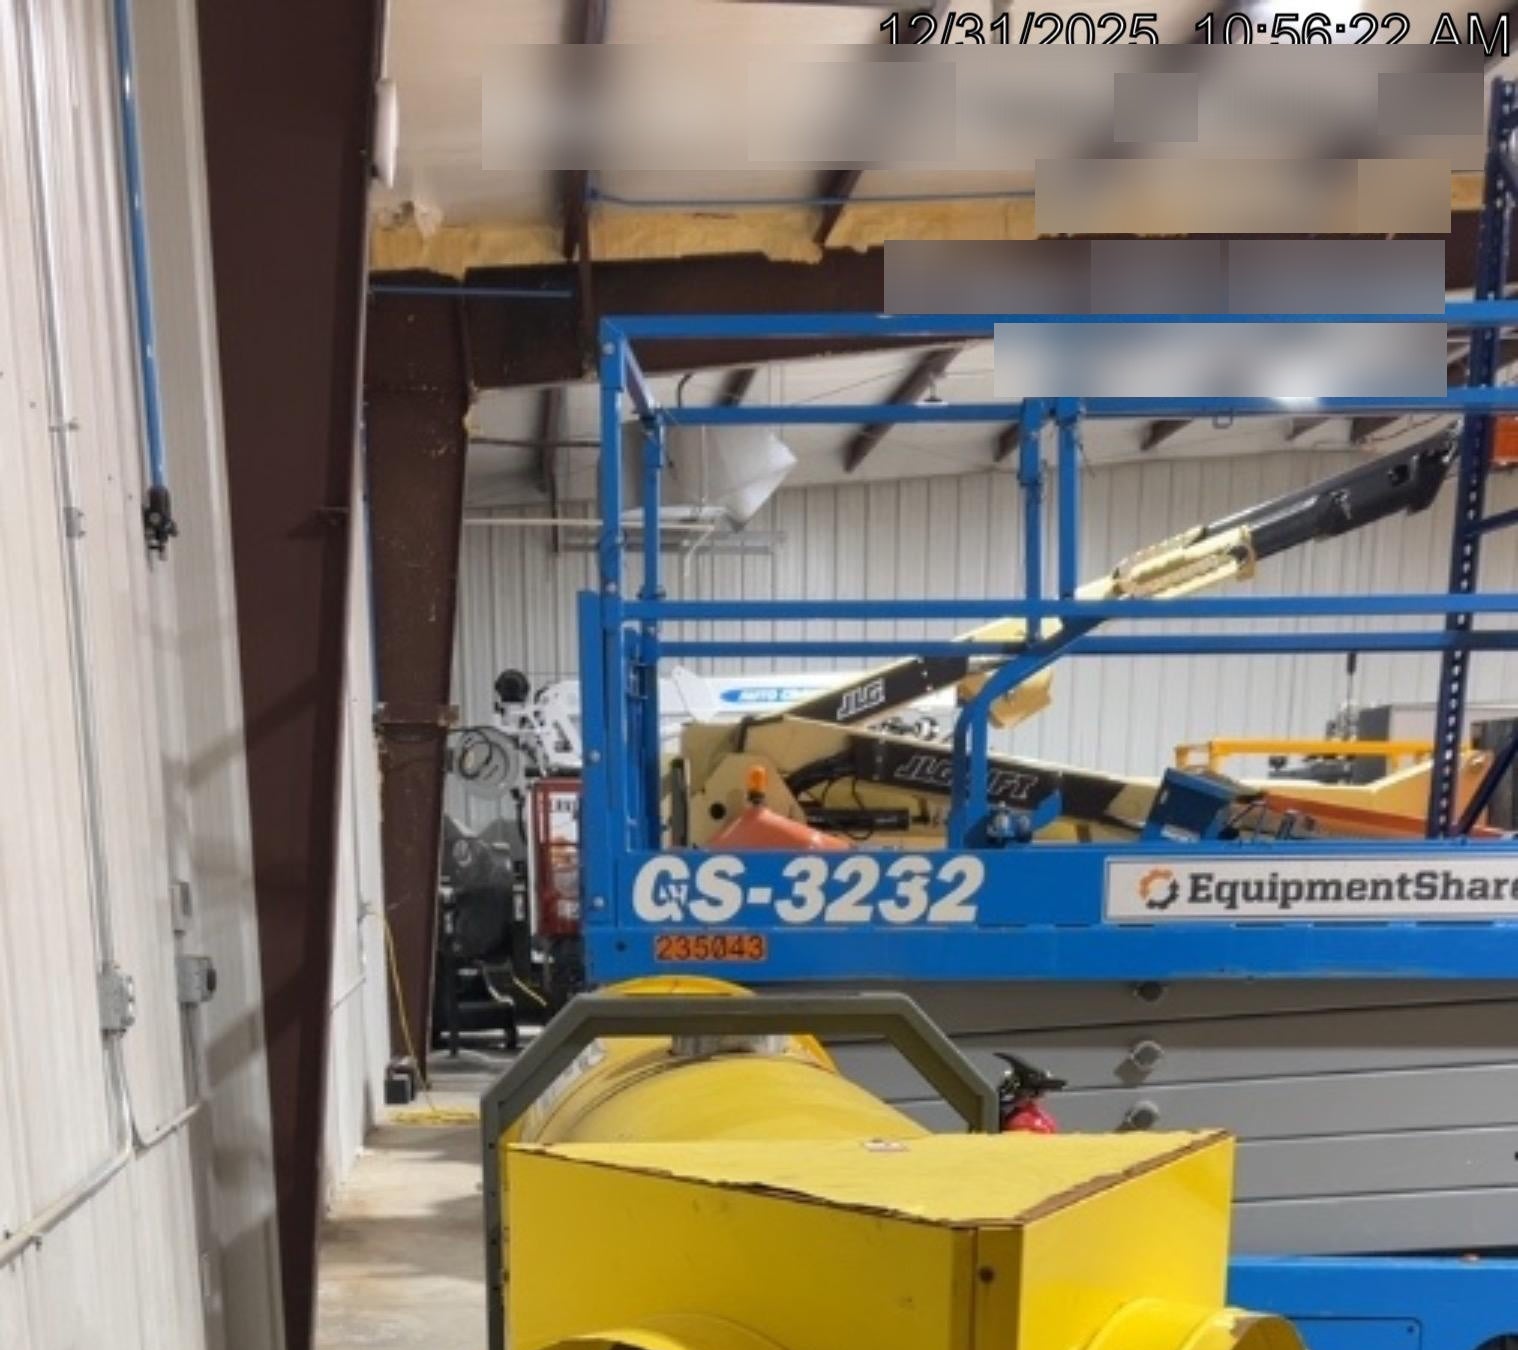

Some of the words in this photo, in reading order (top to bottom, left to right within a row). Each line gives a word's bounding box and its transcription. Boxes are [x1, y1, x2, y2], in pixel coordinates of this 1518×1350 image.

[836, 678, 886, 721] JLG
[632, 855, 985, 922] GS-3232
[656, 934, 764, 961] 235043
